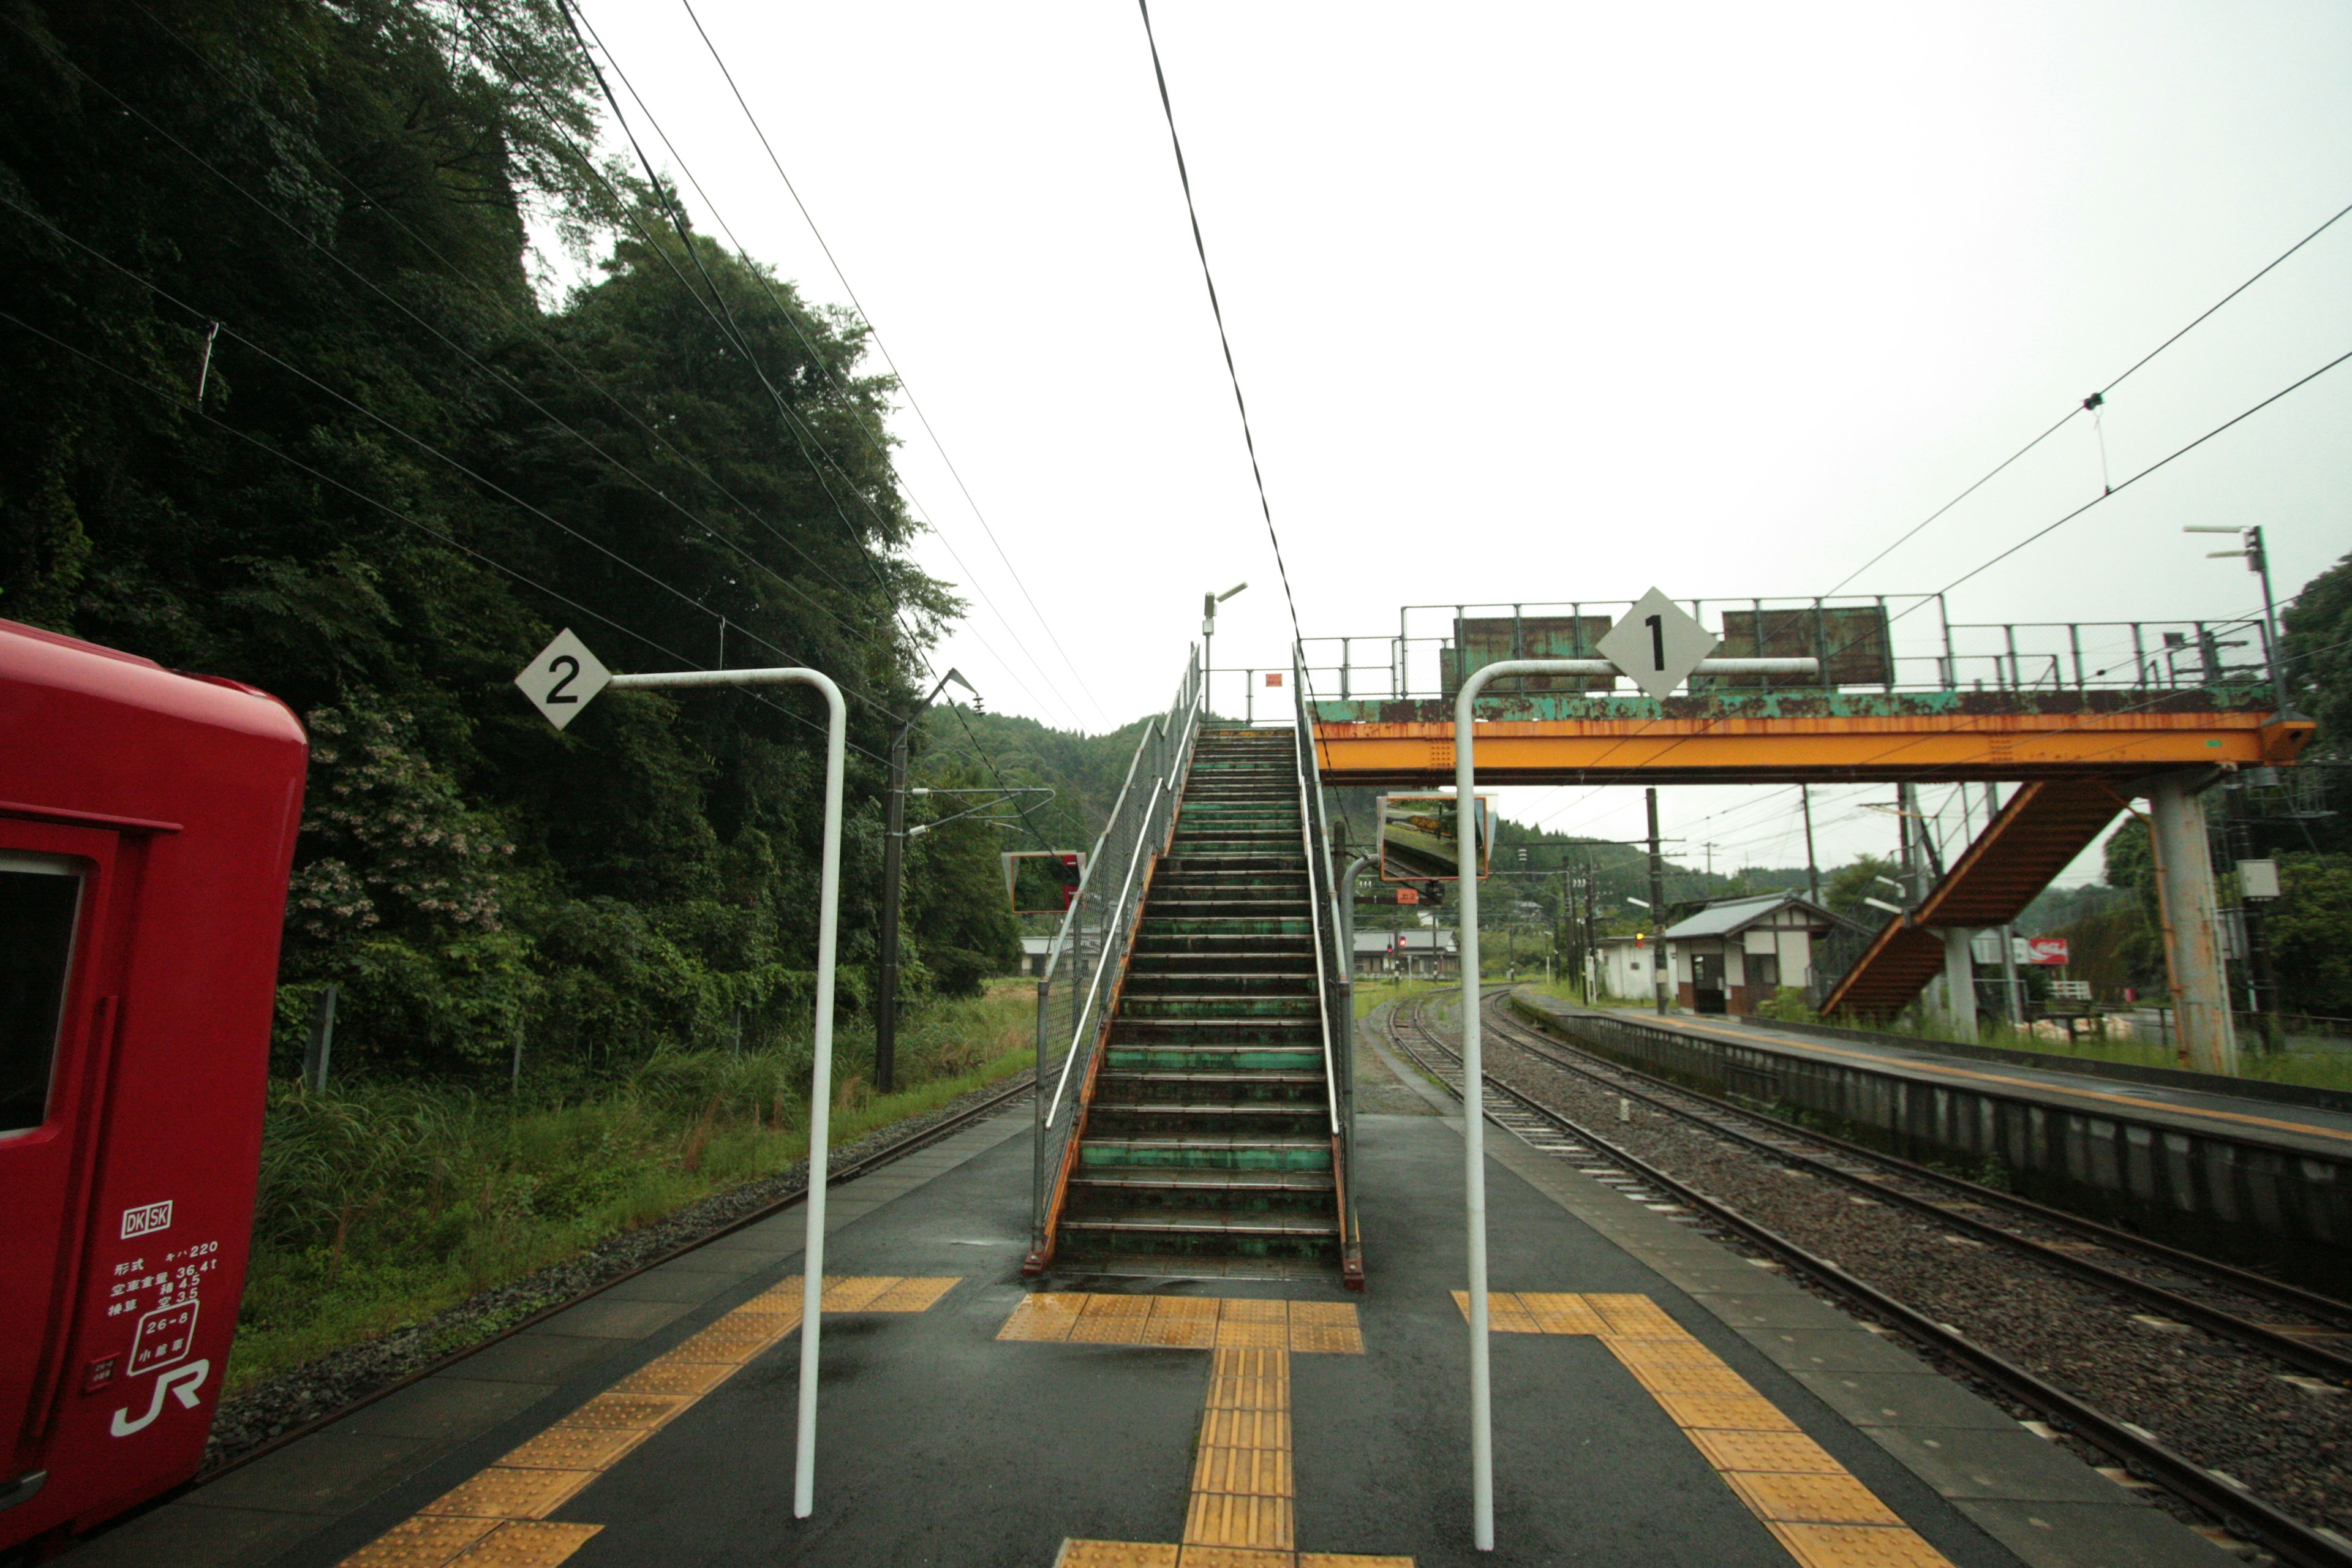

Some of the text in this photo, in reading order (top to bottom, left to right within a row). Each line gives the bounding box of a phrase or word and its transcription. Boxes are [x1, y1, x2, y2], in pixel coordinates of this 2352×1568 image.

[1645, 615, 1664, 671] 1
[546, 655, 579, 703] 2
[127, 1207, 168, 1232] DK SK
[114, 1258, 144, 1275] 形式
[110, 1272, 168, 1297] 空車重量
[179, 1274, 200, 1289] 4.5
[108, 1287, 198, 1316] 換算 空 3.5
[146, 1312, 188, 1334] 26-8
[110, 1359, 209, 1437] JR
